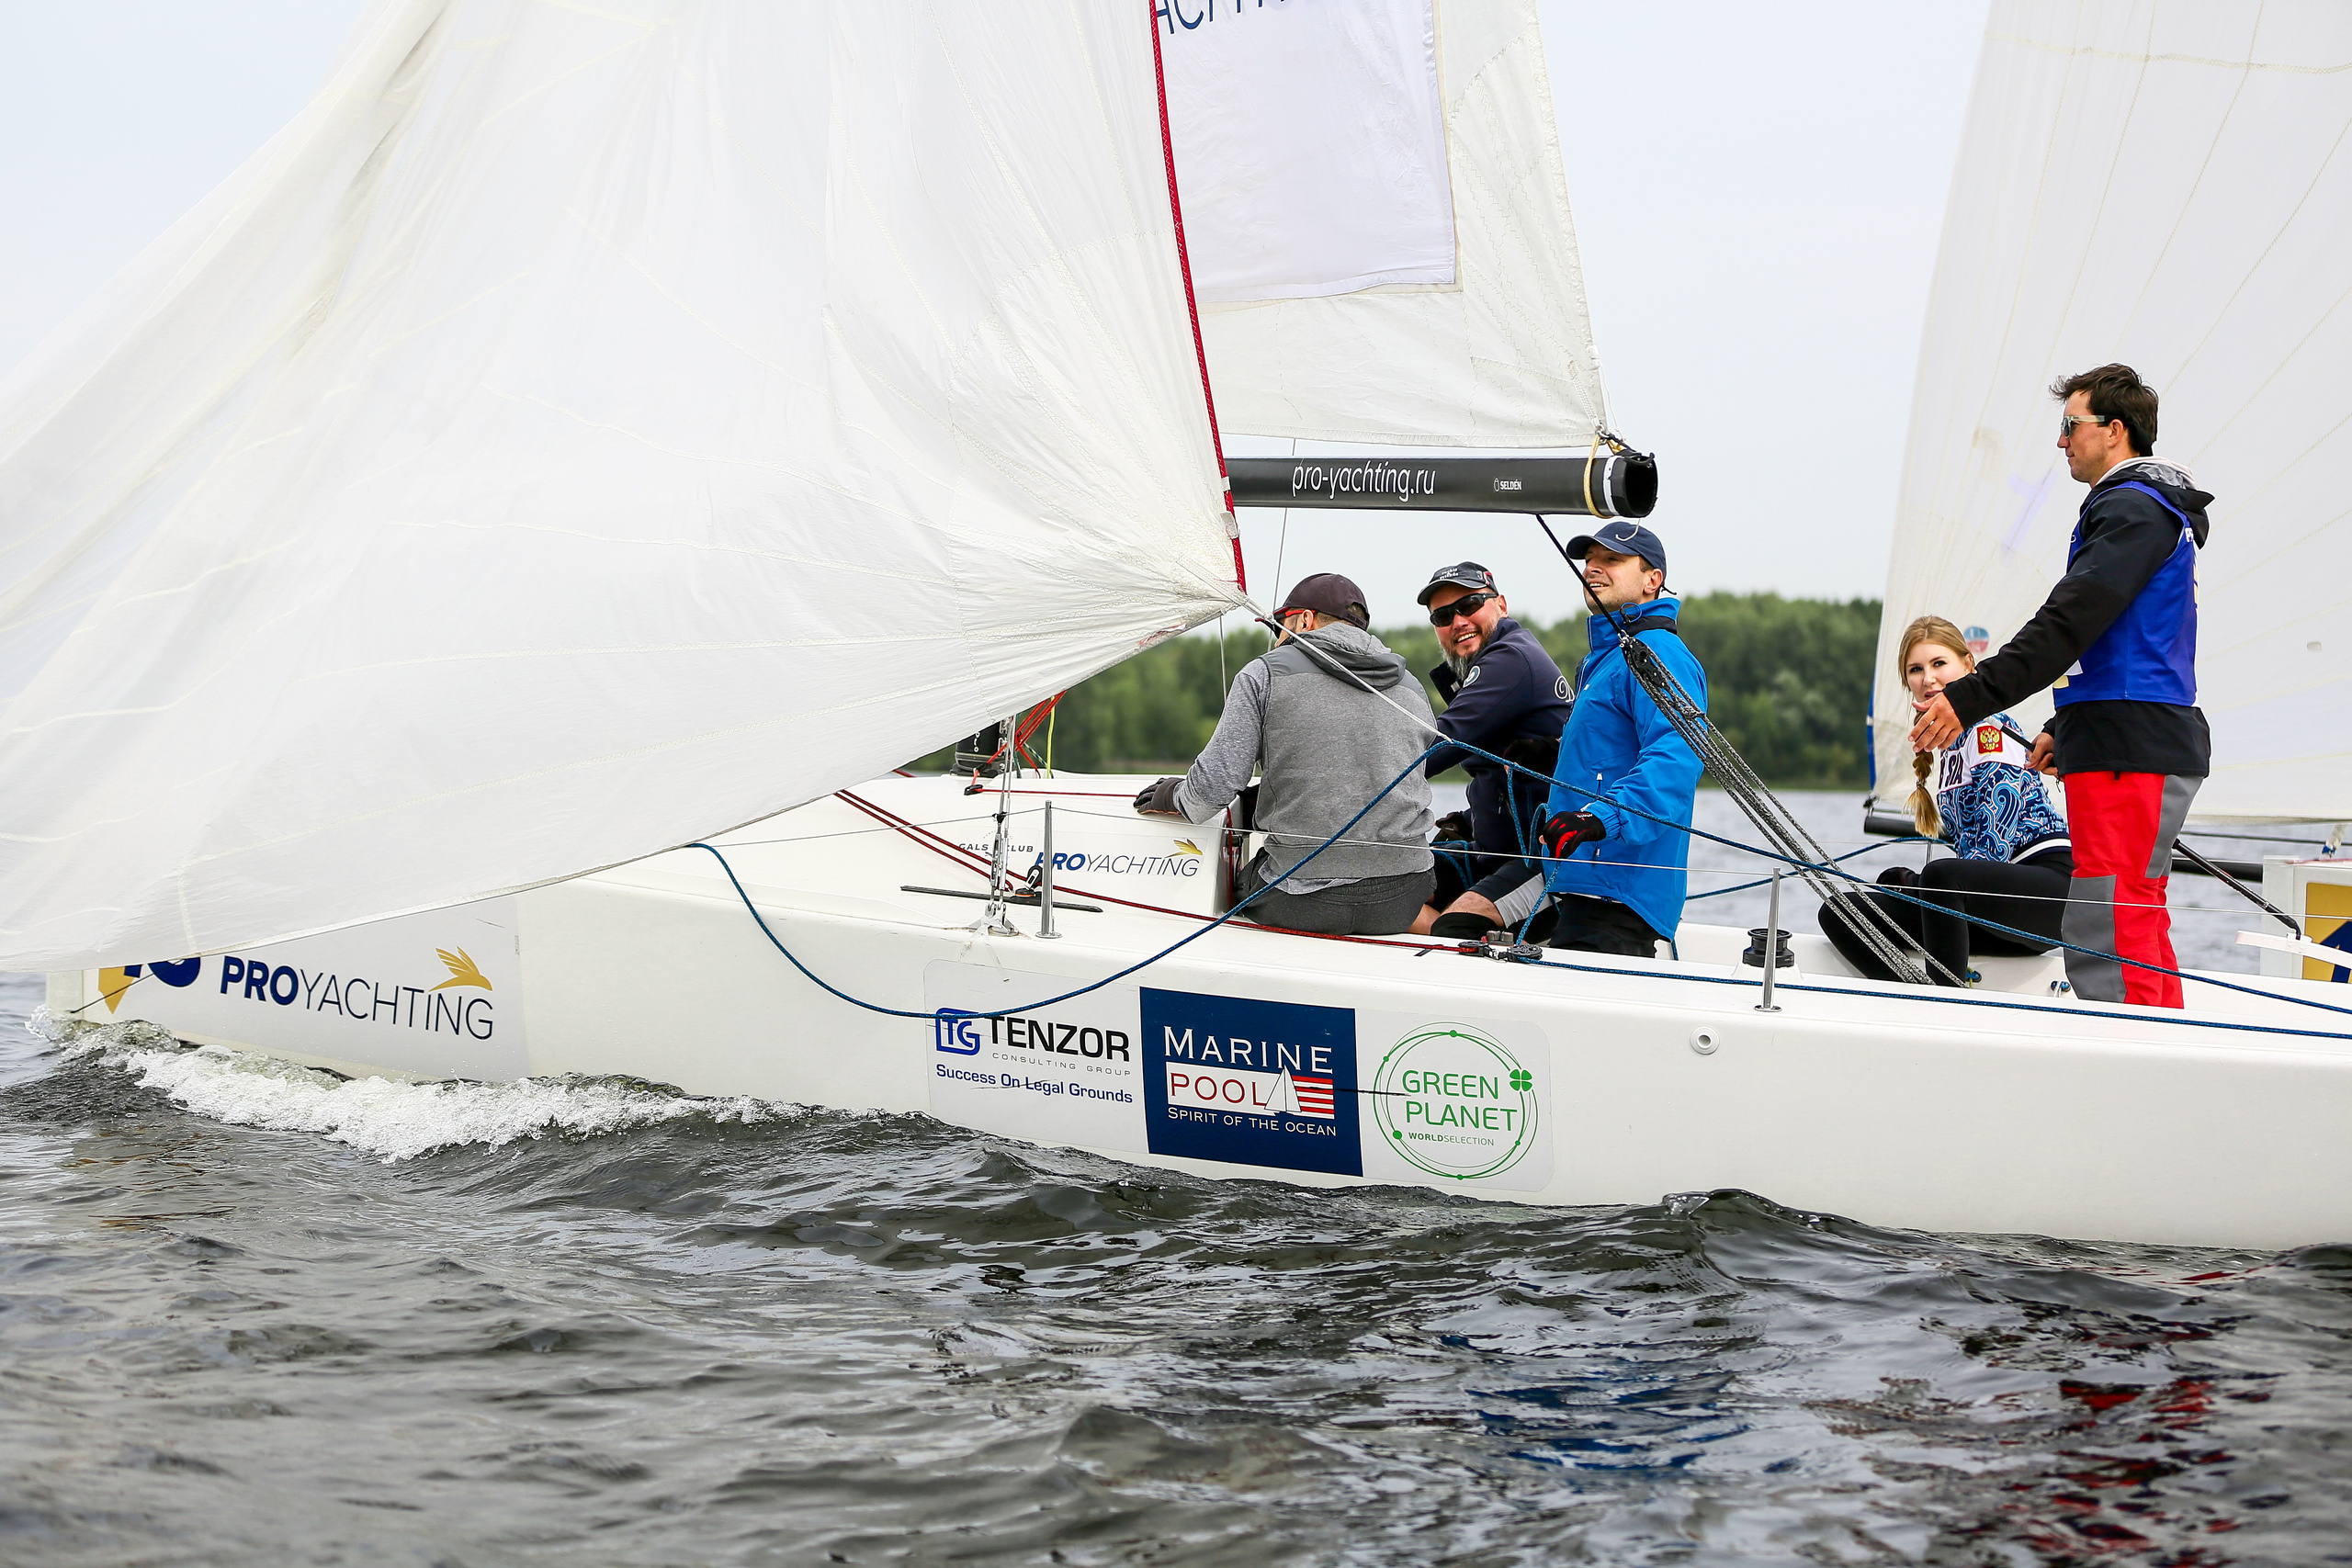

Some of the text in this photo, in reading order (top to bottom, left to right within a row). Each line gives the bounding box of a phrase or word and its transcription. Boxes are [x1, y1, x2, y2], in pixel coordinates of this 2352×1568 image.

[1291, 460, 1436, 502] pro-yachting.ru
[1499, 479, 1522, 491] SELDÉN
[1007, 844, 1034, 852] LUB
[220, 955, 494, 1040] PROYACHTING
[984, 1015, 1130, 1063] TENZOR
[1163, 1025, 1333, 1074] MARINE
[992, 1052, 1131, 1077] CONSULTING GROUP
[936, 1064, 1134, 1104] Success On Legal Grounds
[1170, 1072, 1268, 1107] POOL
[1402, 1069, 1499, 1100] GREEN
[1168, 1106, 1338, 1137] SPIRIT OF THE OCEAN
[1406, 1100, 1518, 1132] PLANET
